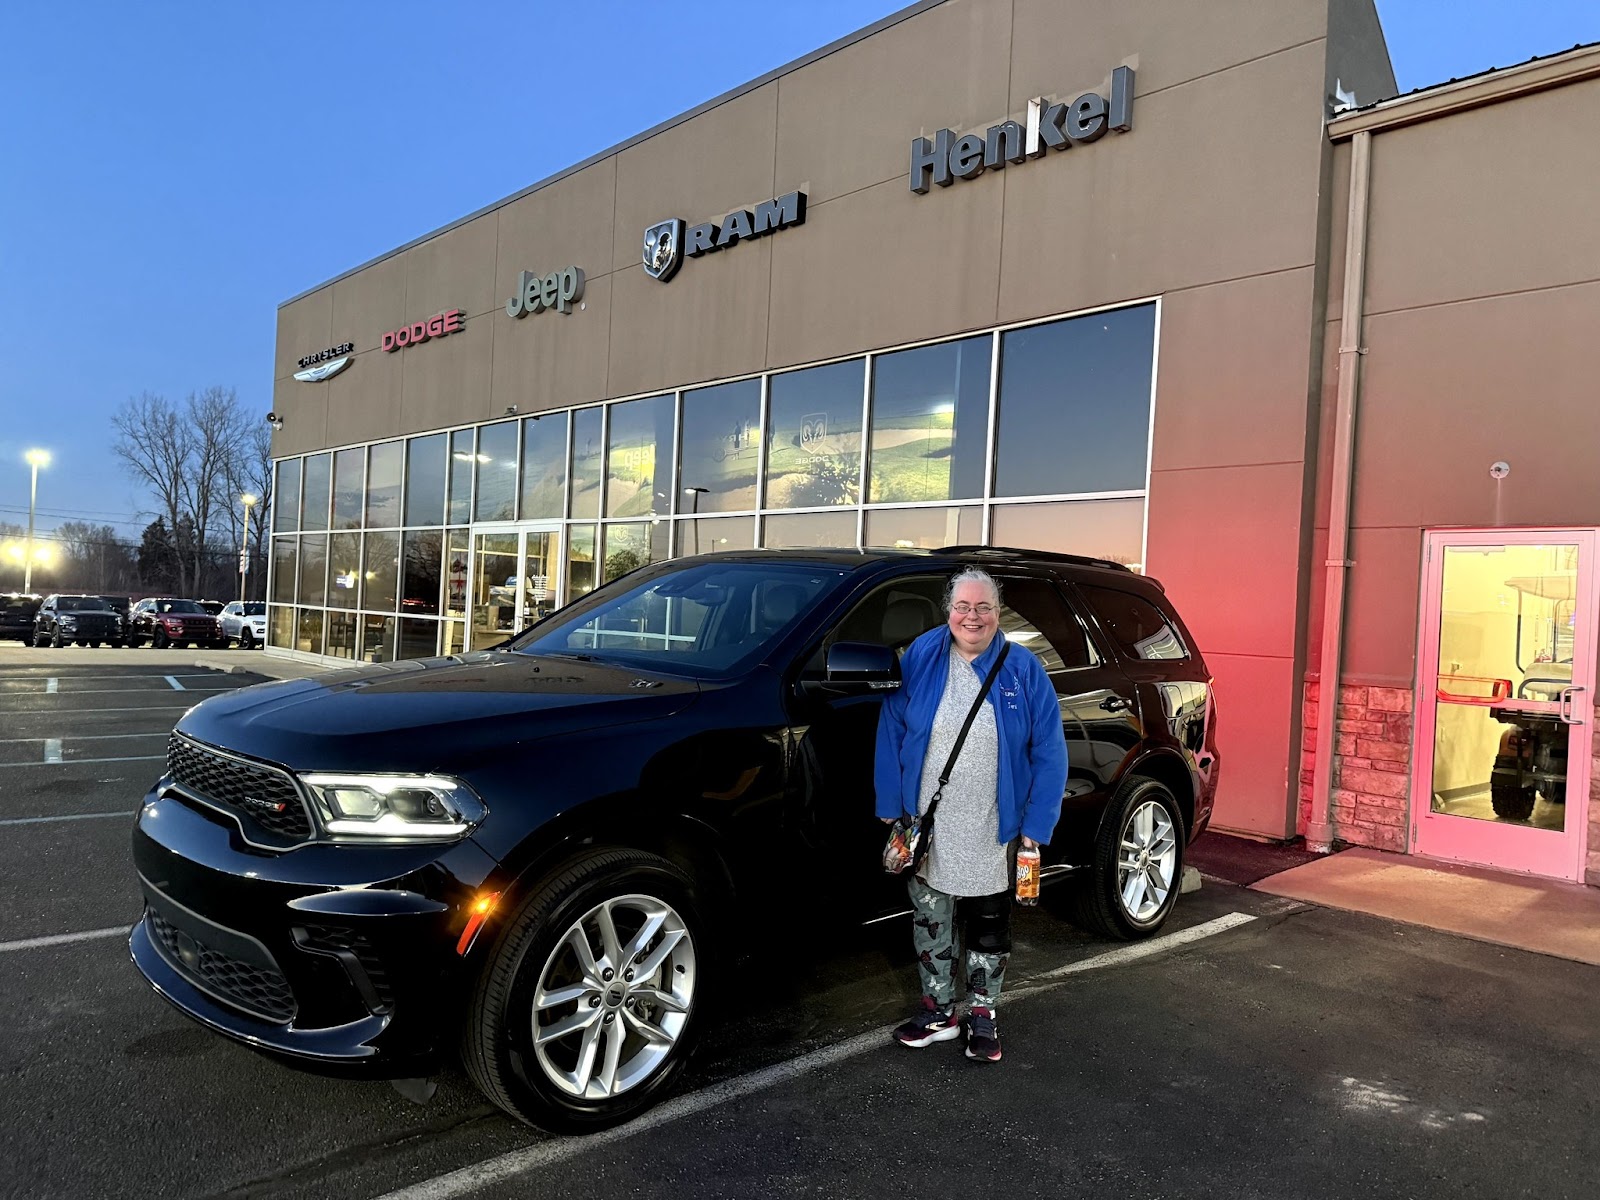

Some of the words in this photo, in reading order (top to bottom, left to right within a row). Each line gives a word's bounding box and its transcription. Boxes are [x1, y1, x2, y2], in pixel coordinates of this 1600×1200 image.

[909, 65, 1135, 195] Henkel
[685, 189, 807, 258] RAM
[506, 265, 585, 318] Jeep
[297, 342, 354, 368] CHRYSLER
[381, 308, 467, 353] DODGE
